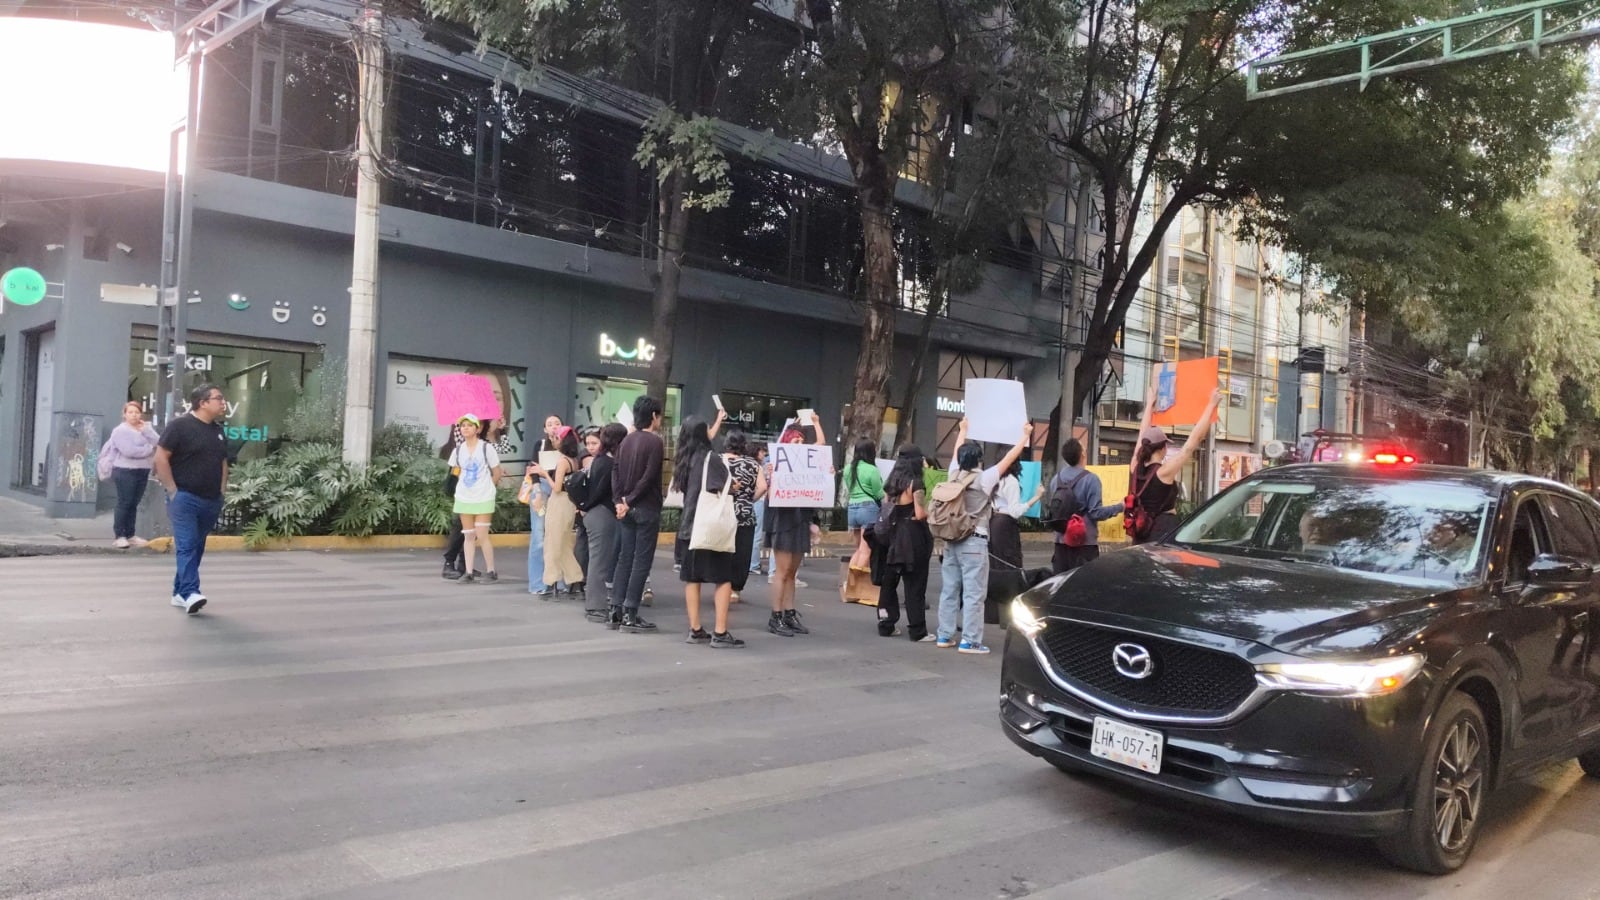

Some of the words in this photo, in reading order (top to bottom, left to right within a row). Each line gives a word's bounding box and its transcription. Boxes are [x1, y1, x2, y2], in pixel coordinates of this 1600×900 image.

[936, 396, 965, 413] Mont
[223, 422, 269, 441] ista!
[774, 446, 819, 473] AXE
[1094, 727, 1159, 761] LHK-057-A
